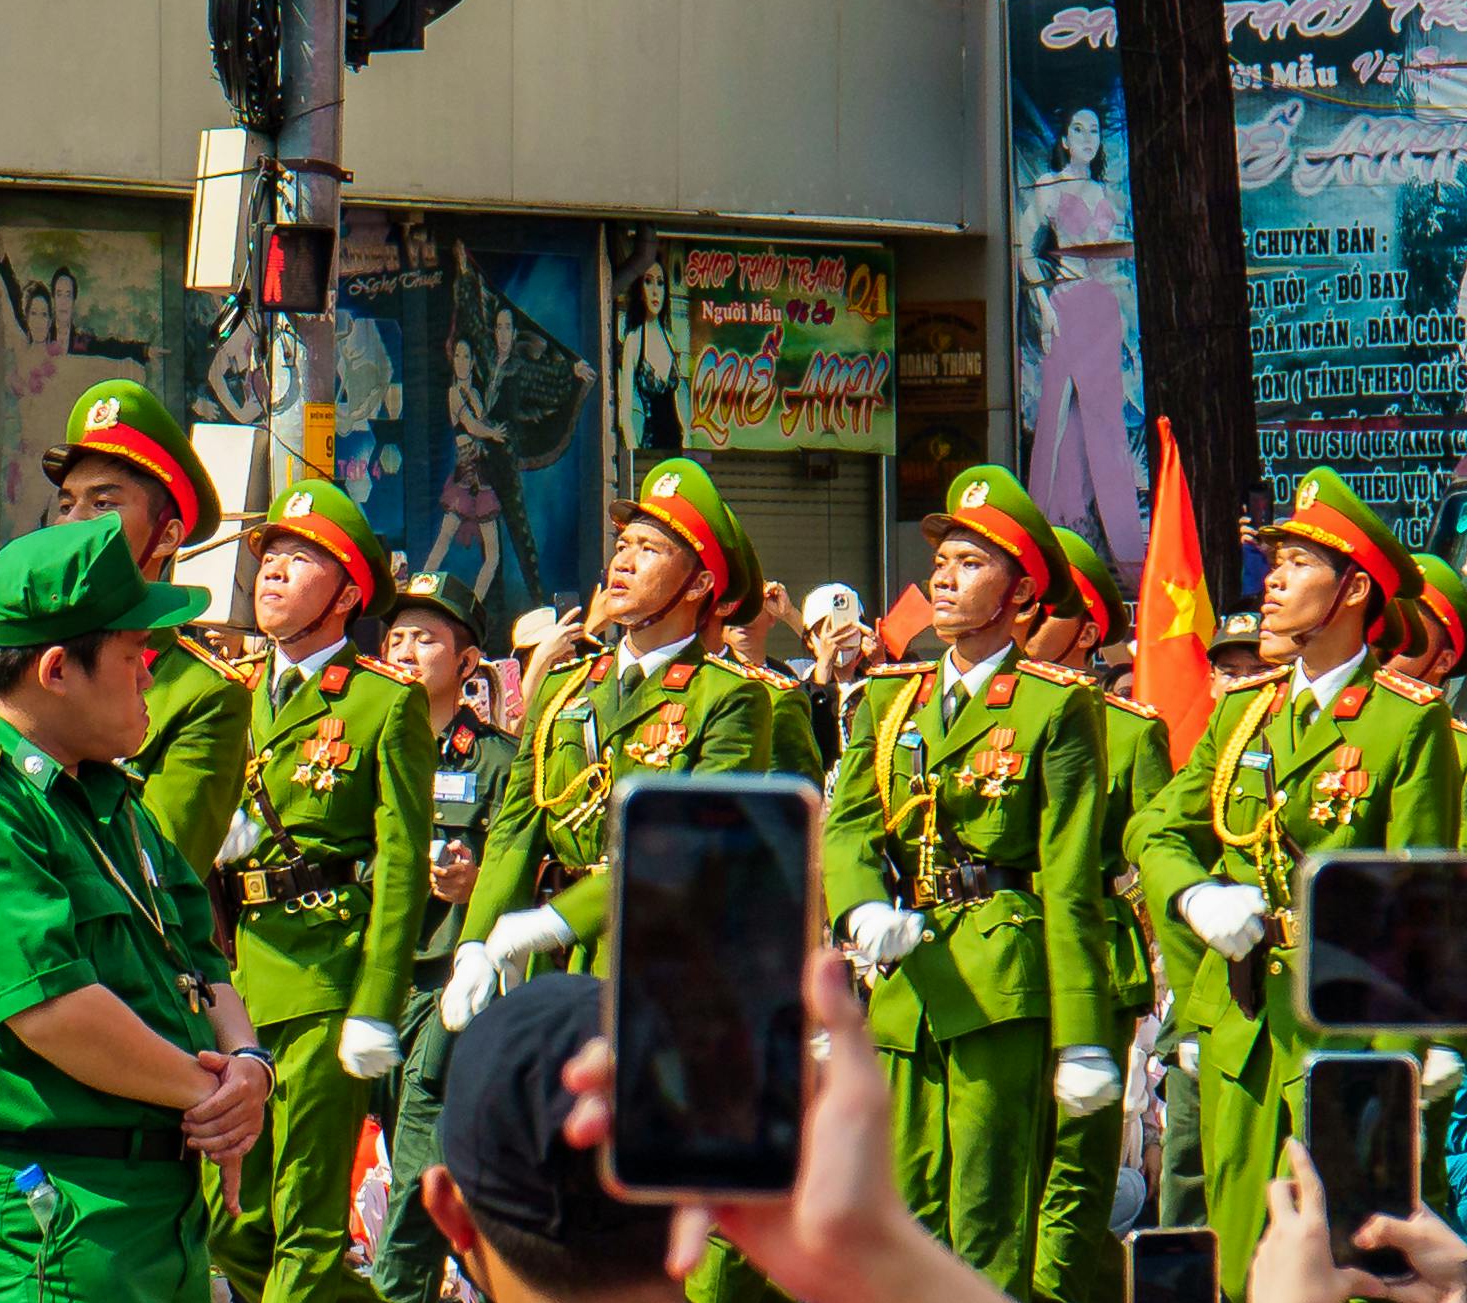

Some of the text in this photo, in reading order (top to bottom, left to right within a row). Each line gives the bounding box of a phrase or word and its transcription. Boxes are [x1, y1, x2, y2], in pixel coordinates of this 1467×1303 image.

[1254, 222, 1331, 258] CHUYÊN
[1336, 219, 1376, 255] BÁN
[685, 249, 736, 289] SHOP
[1368, 270, 1409, 300] BAY
[1414, 308, 1467, 347] CÔNG
[1359, 363, 1415, 397] THEO
